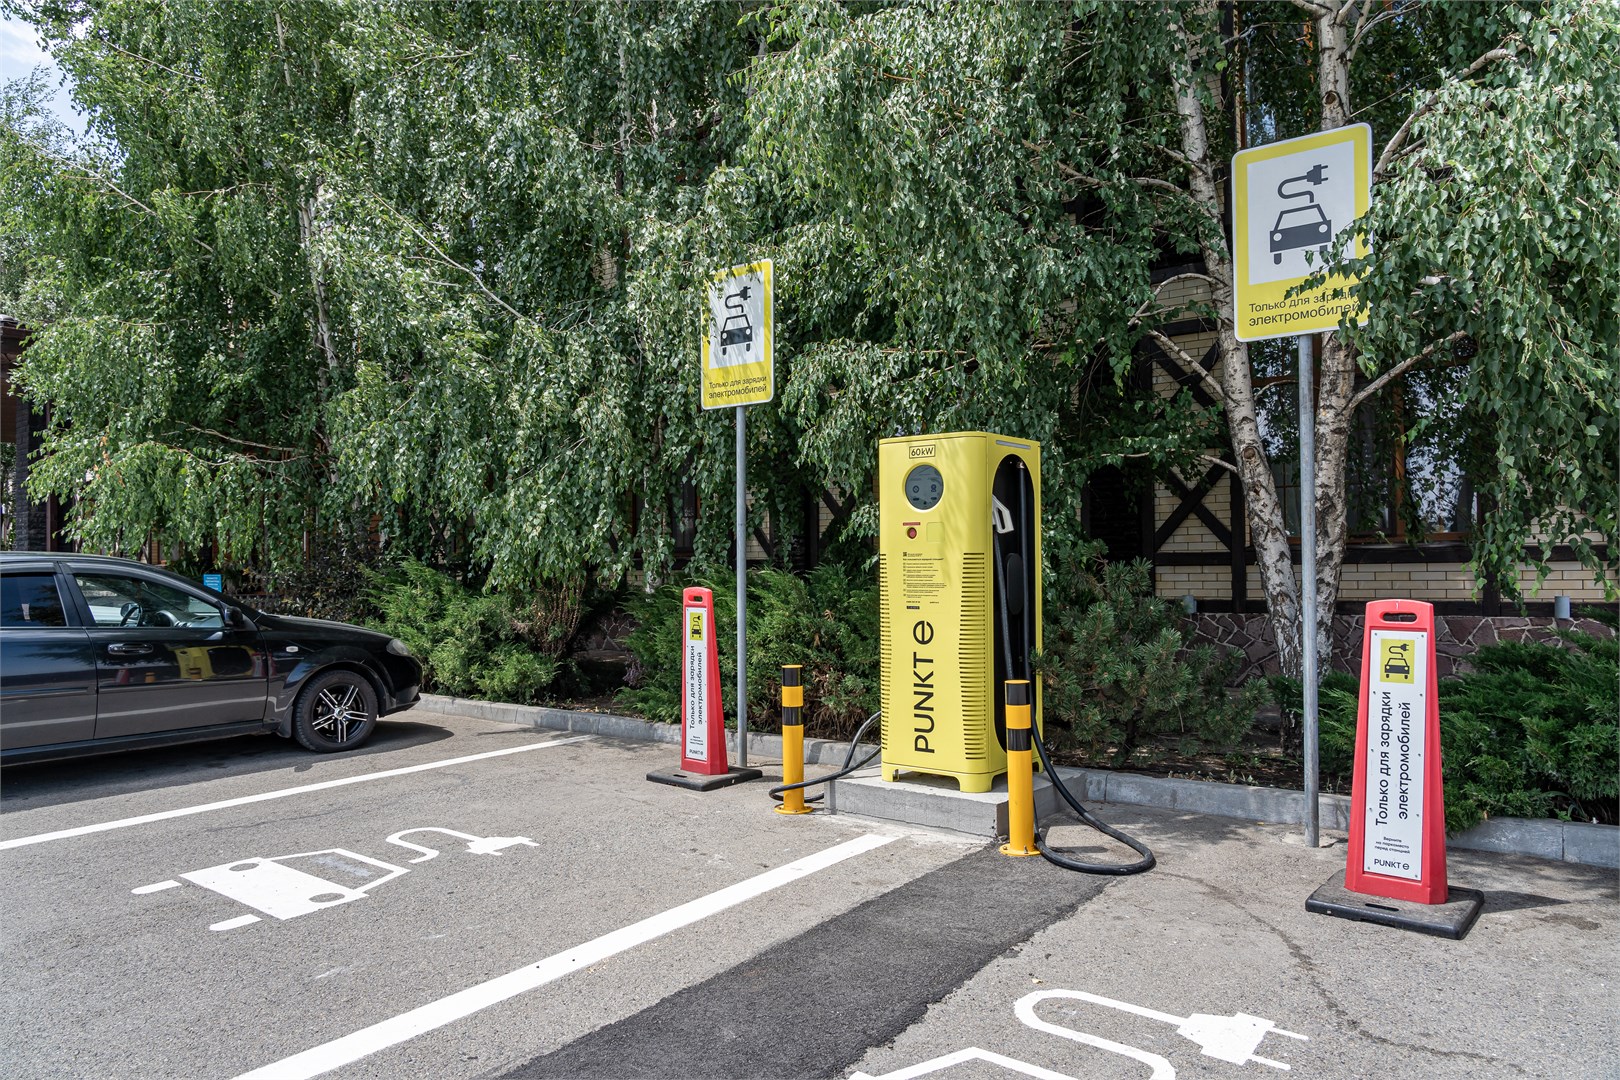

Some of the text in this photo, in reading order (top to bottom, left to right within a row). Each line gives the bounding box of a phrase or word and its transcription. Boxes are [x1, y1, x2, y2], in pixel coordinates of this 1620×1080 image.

[1249, 300, 1286, 313] Только
[1288, 297, 1310, 309] для
[709, 376, 767, 389] Только для зарядки
[708, 384, 767, 399] электромобилей
[913, 651, 935, 753] PUNKT
[1375, 691, 1393, 826] Только для зарядки
[1397, 702, 1412, 820] электромобилей
[1374, 858, 1401, 869] PUNKT
